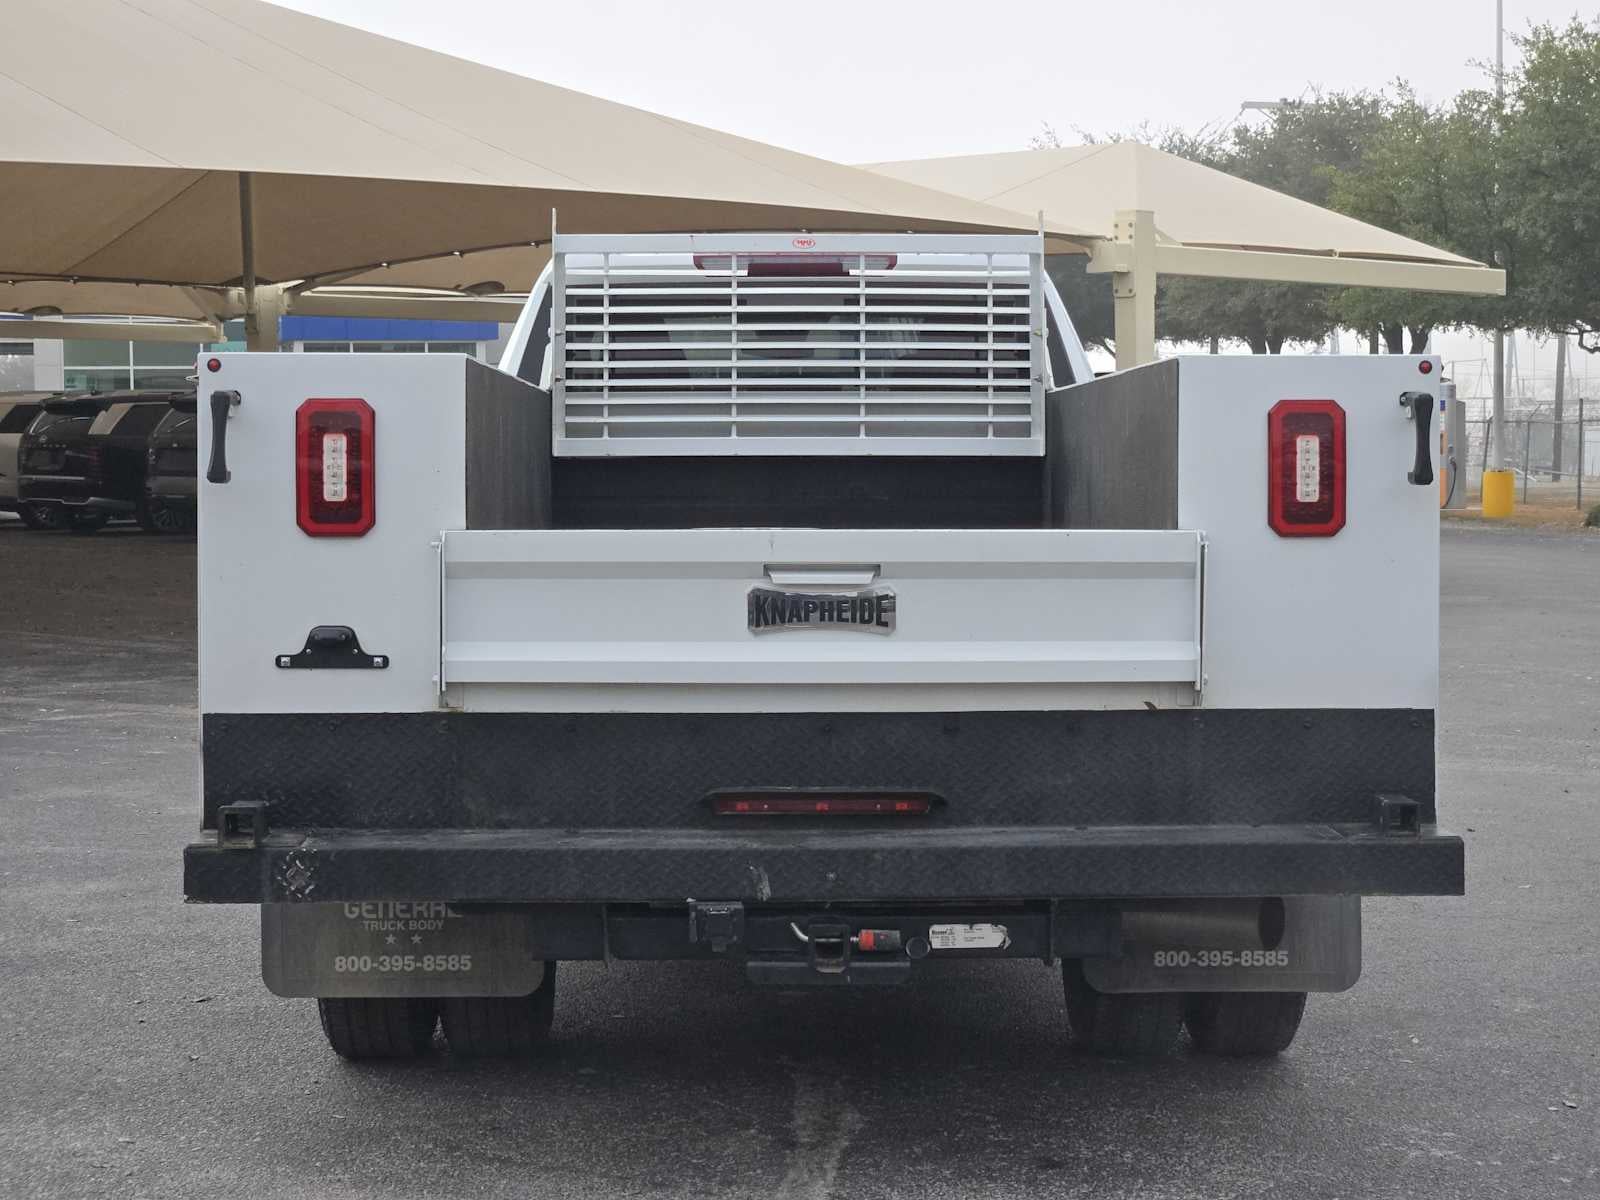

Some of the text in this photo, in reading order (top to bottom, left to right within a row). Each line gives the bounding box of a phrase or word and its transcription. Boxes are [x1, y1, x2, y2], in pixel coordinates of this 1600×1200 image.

[754, 593, 889, 628] KNAPHEIDE
[363, 919, 445, 931] TRUCK BODY
[334, 955, 472, 972] 800-395-8585
[1153, 950, 1289, 967] 800-395-8585
